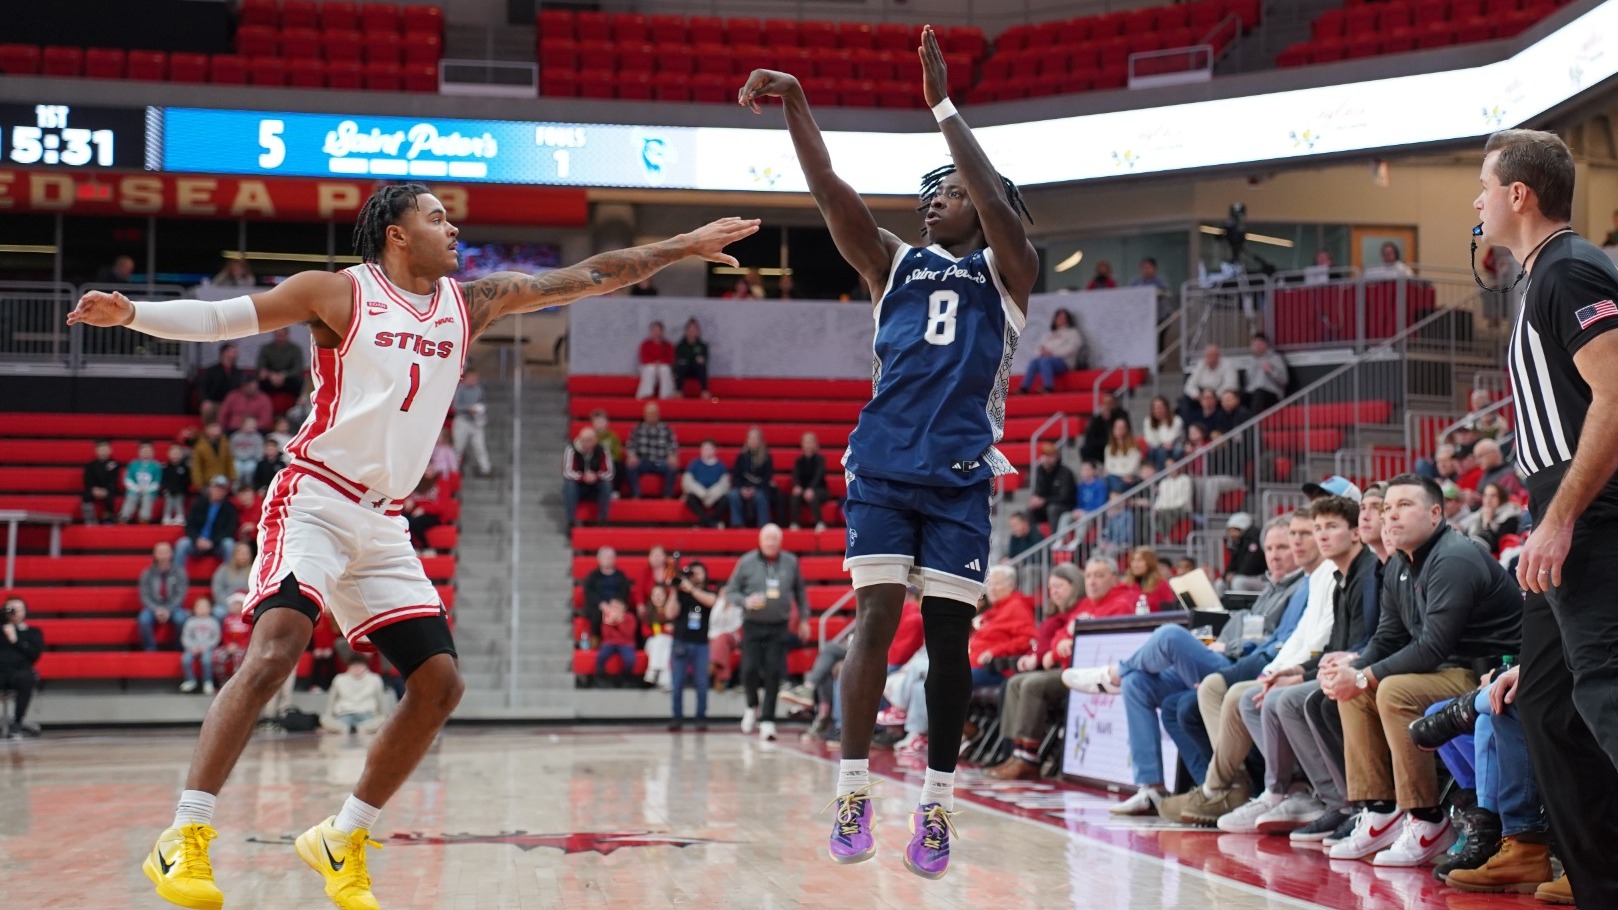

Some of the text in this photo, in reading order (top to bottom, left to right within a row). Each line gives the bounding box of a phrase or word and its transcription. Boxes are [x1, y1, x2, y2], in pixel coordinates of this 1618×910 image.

[35, 104, 70, 128] 1ST
[0, 125, 114, 166] 5:31
[258, 119, 286, 169] 5
[322, 120, 499, 159] Saint Peter's
[552, 149, 570, 178] 1
[118, 177, 275, 217] SEA
[317, 183, 470, 221] PB
[924, 289, 959, 346] 8
[400, 362, 420, 412] 1
